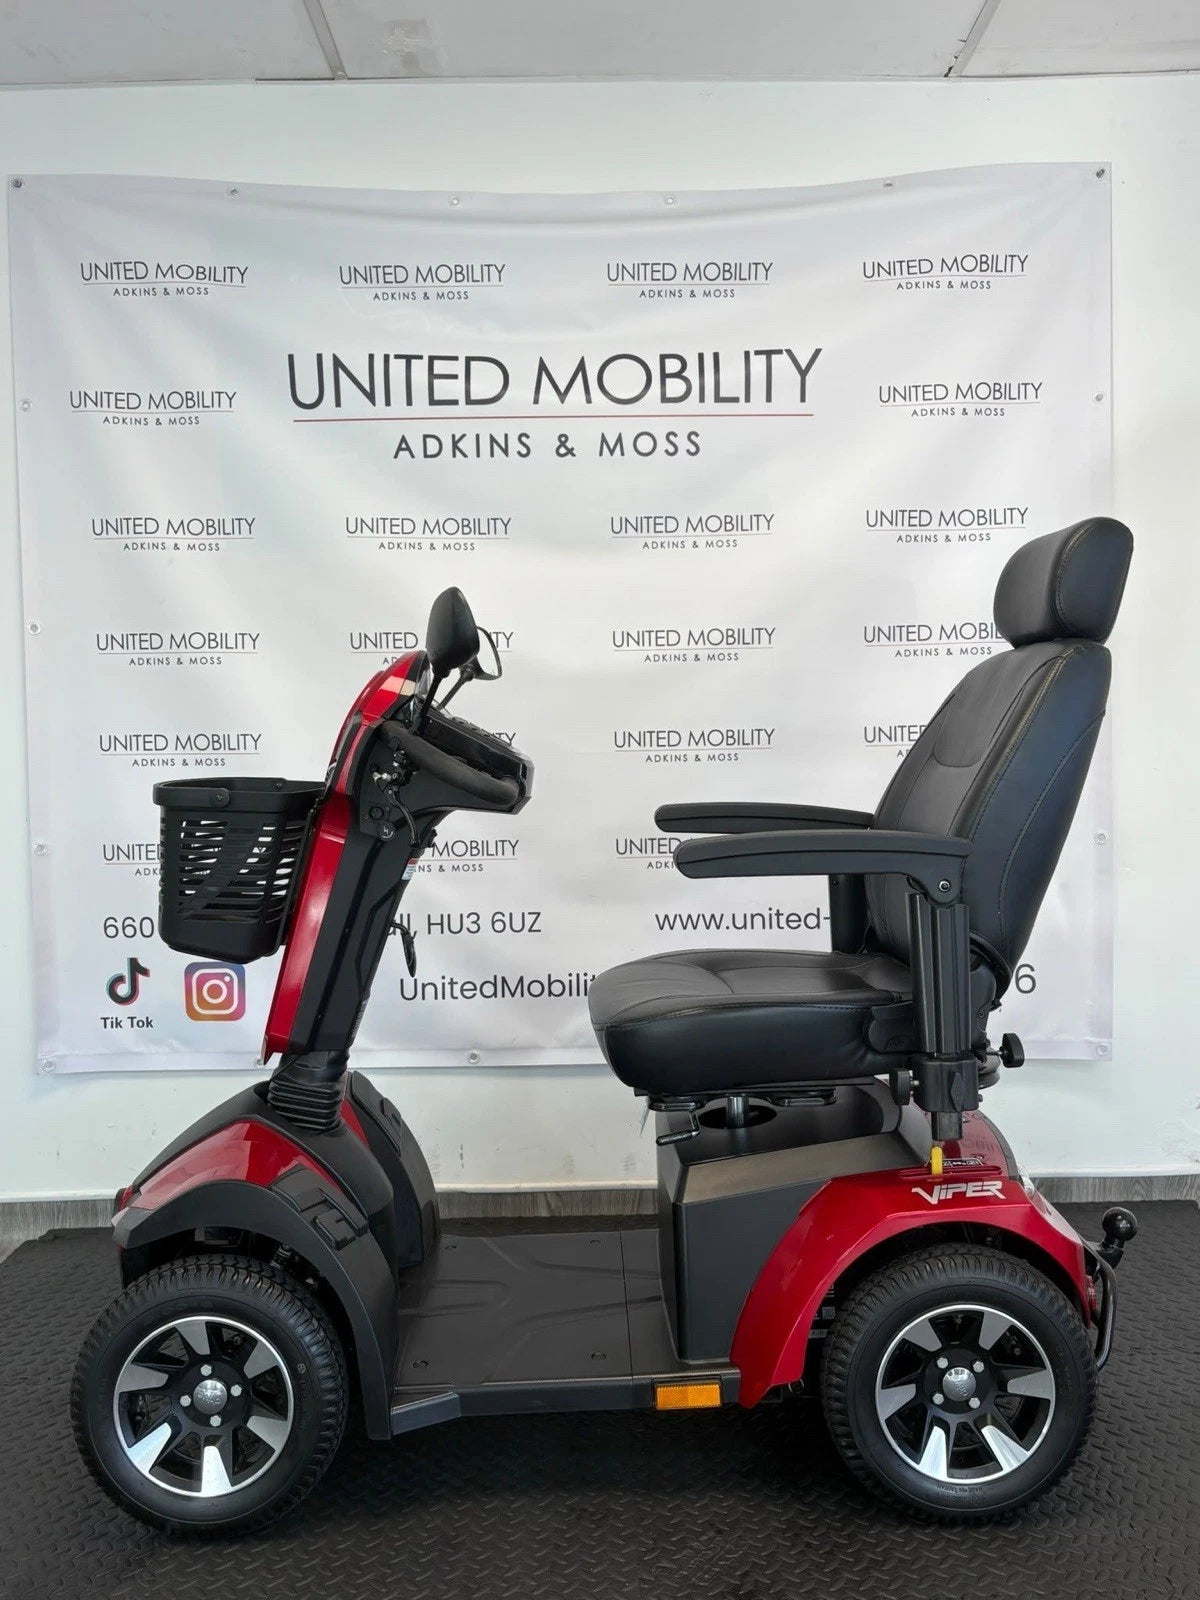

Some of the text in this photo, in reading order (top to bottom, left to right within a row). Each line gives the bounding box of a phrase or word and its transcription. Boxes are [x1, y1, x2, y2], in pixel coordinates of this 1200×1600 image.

[81, 261, 248, 284] UNITED MOBILITY
[340, 264, 505, 285] UNITED MOBILITY
[608, 262, 773, 281] UNITED MOBILITY
[863, 254, 1028, 279] UNITED MOBILITY
[114, 287, 209, 296] ADKINS & MOSS
[639, 289, 735, 298] ADKINS & MOSS
[897, 280, 991, 290] ADKINS & MOSS
[373, 291, 468, 300] ADKINS & MOSS
[288, 348, 822, 410] UNITED MOBILITY
[70, 391, 236, 410] UNITED MOBILITY
[879, 382, 1042, 403] UNITED MOBILITY
[103, 416, 148, 426] ADKINS
[169, 416, 199, 425] MOSS
[911, 407, 955, 417] ADKINS
[974, 408, 1004, 416] MOSS
[393, 431, 700, 459] ADKINS & MOSS
[346, 517, 511, 535] UNITED MOBILITY
[611, 514, 774, 534] UNITED MOBILITY
[867, 507, 1028, 527] UNITED MOBILITY
[92, 518, 255, 536] UNITED MOBILITY
[124, 542, 166, 550] ADKINS
[187, 543, 219, 551] MOSS
[379, 542, 422, 550] ADKINS
[443, 542, 475, 551] MOSS
[643, 540, 685, 549] ADKINS
[705, 539, 737, 548] MOSS
[897, 534, 938, 543] ADKINS
[958, 533, 990, 542] MOSS
[97, 632, 259, 651] UNITED MOBILITY
[350, 632, 418, 650] UNITED
[613, 628, 775, 648] UNITED MOBILITY
[864, 625, 932, 643] UNITED
[129, 656, 221, 665] ADKINS & MOSS
[644, 654, 687, 662] ADKINS
[707, 653, 738, 661] MOSS
[895, 648, 939, 657] ADKINS
[960, 647, 991, 655] MOSS
[100, 734, 261, 752] UNITED MOBILITY
[615, 729, 775, 748] UNITED MOBILITY
[132, 758, 175, 767] ADKINS
[195, 758, 225, 766] MOSS
[646, 753, 738, 762] ADKINS & MOSS
[432, 840, 519, 857] MOBILITY
[438, 865, 446, 873] &
[452, 864, 484, 873] MOSS
[104, 917, 154, 938] 660
[428, 912, 480, 934] HU3
[491, 912, 541, 933] 6UZ
[100, 1016, 153, 1029] Tik Tok
